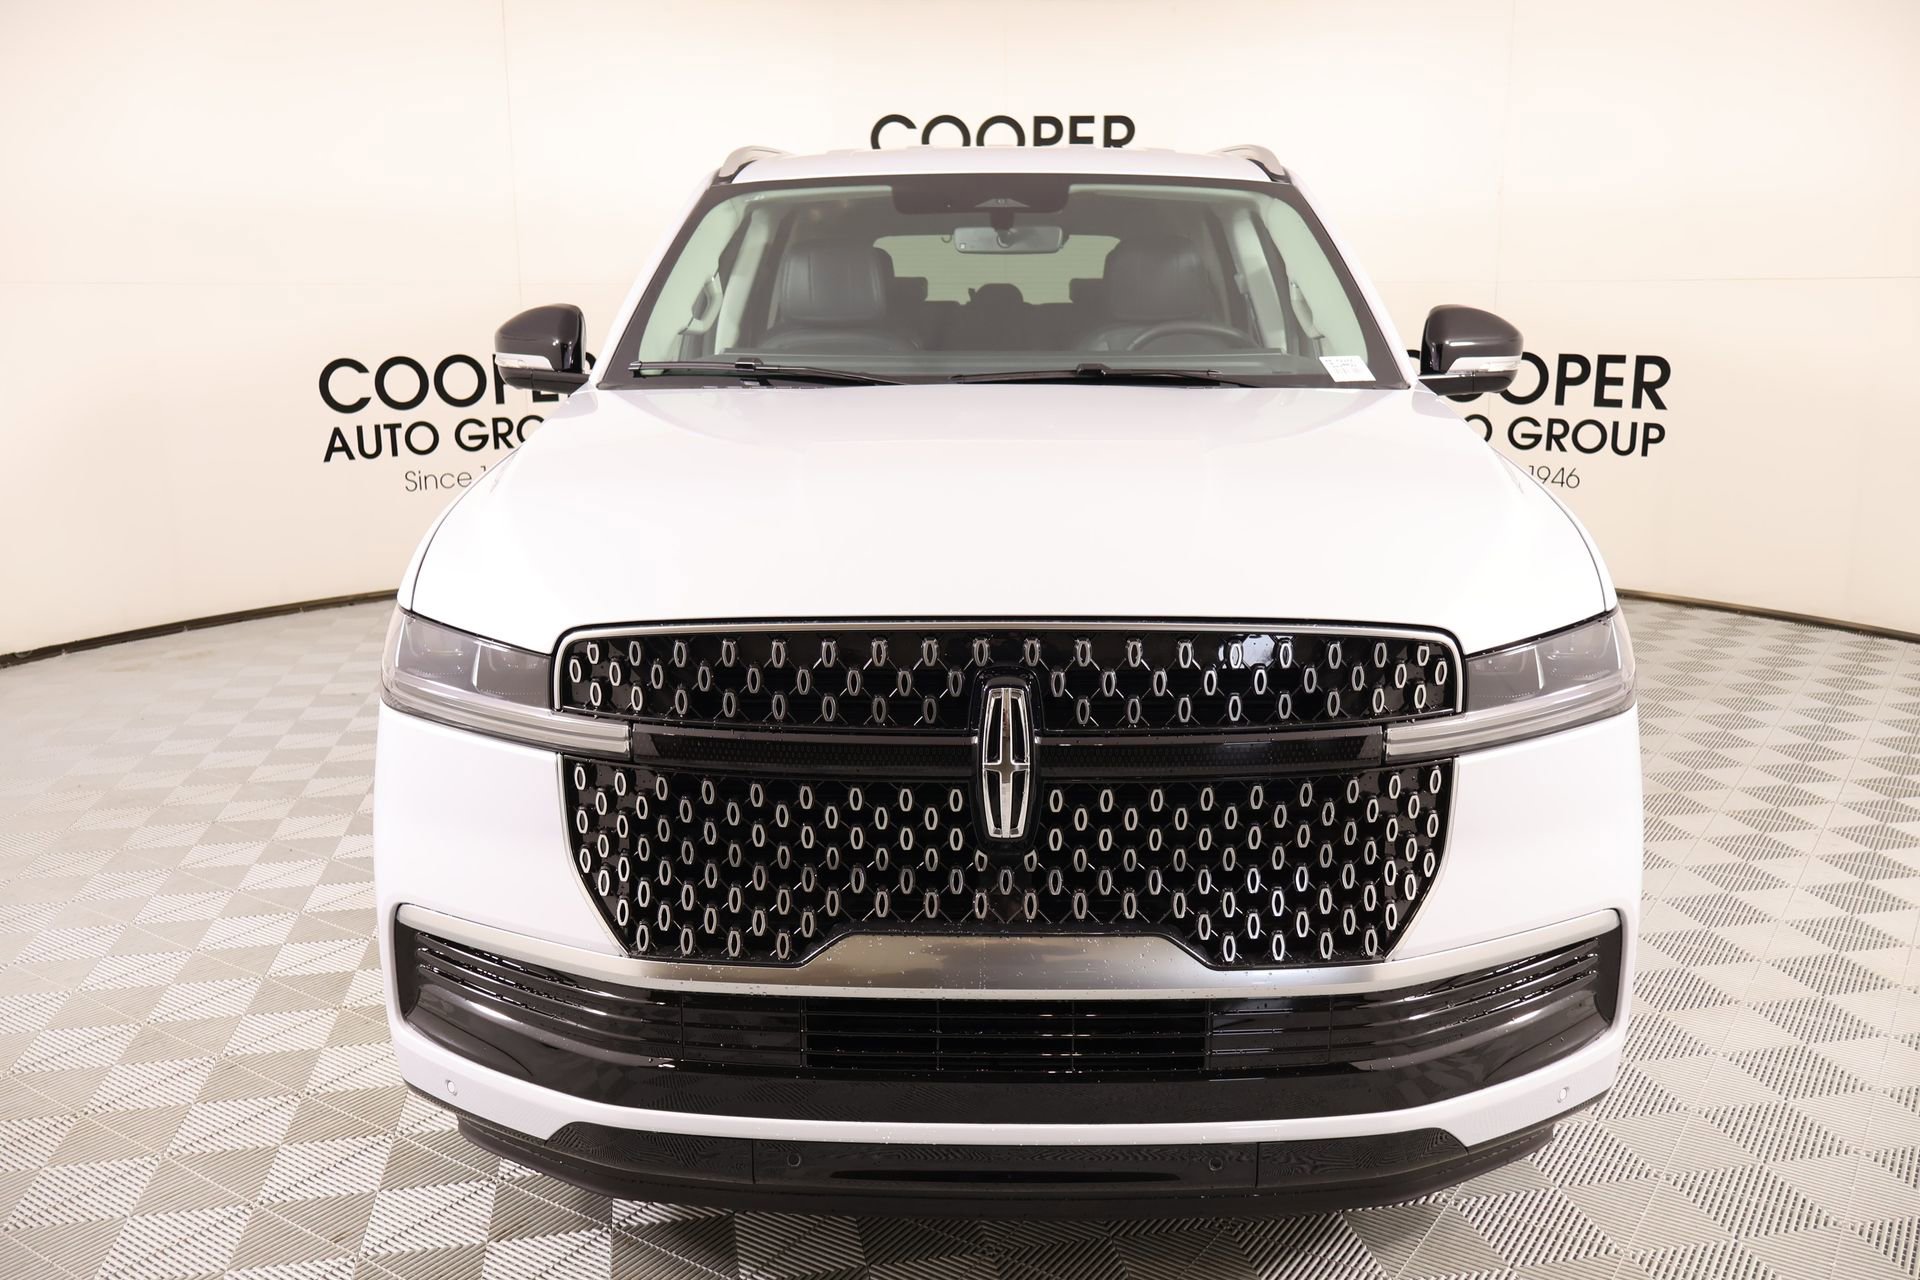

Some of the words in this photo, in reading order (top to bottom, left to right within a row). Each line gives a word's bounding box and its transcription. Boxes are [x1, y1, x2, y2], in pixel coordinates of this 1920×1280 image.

[870, 114, 1136, 149] COOPER
[318, 353, 598, 414] COO
[1407, 349, 1672, 411] OPER
[323, 421, 440, 463] AUTO
[1507, 416, 1666, 457] GROUP
[404, 470, 473, 492] Since
